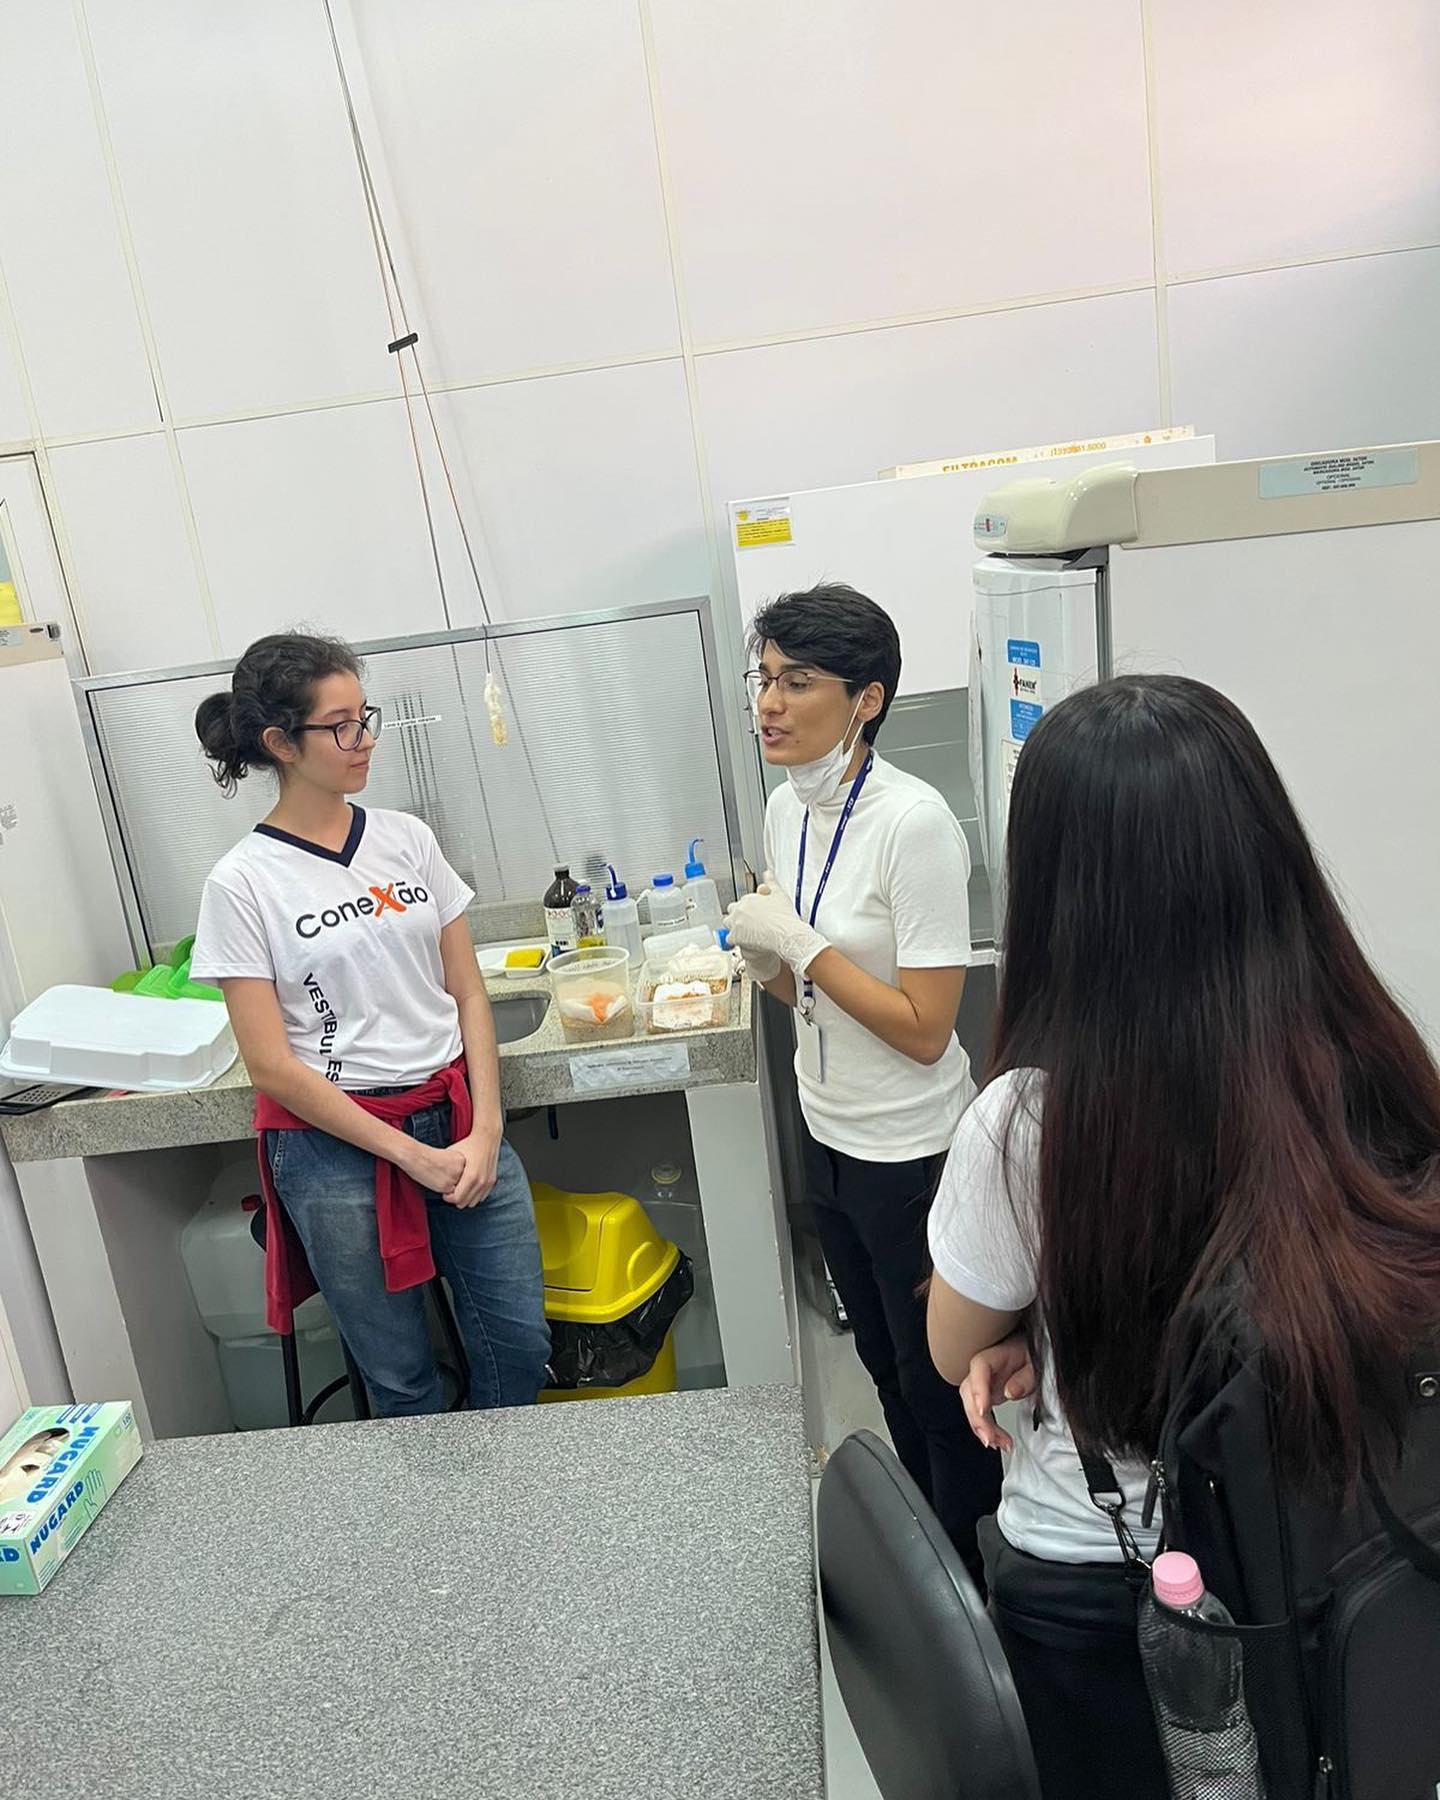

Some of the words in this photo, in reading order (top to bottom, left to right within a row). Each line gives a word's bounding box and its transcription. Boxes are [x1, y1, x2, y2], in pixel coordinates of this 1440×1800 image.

[296, 881, 429, 939] ConeXão
[27, 1426, 100, 1504] NUGARD
[30, 1480, 84, 1556] NUGARD
